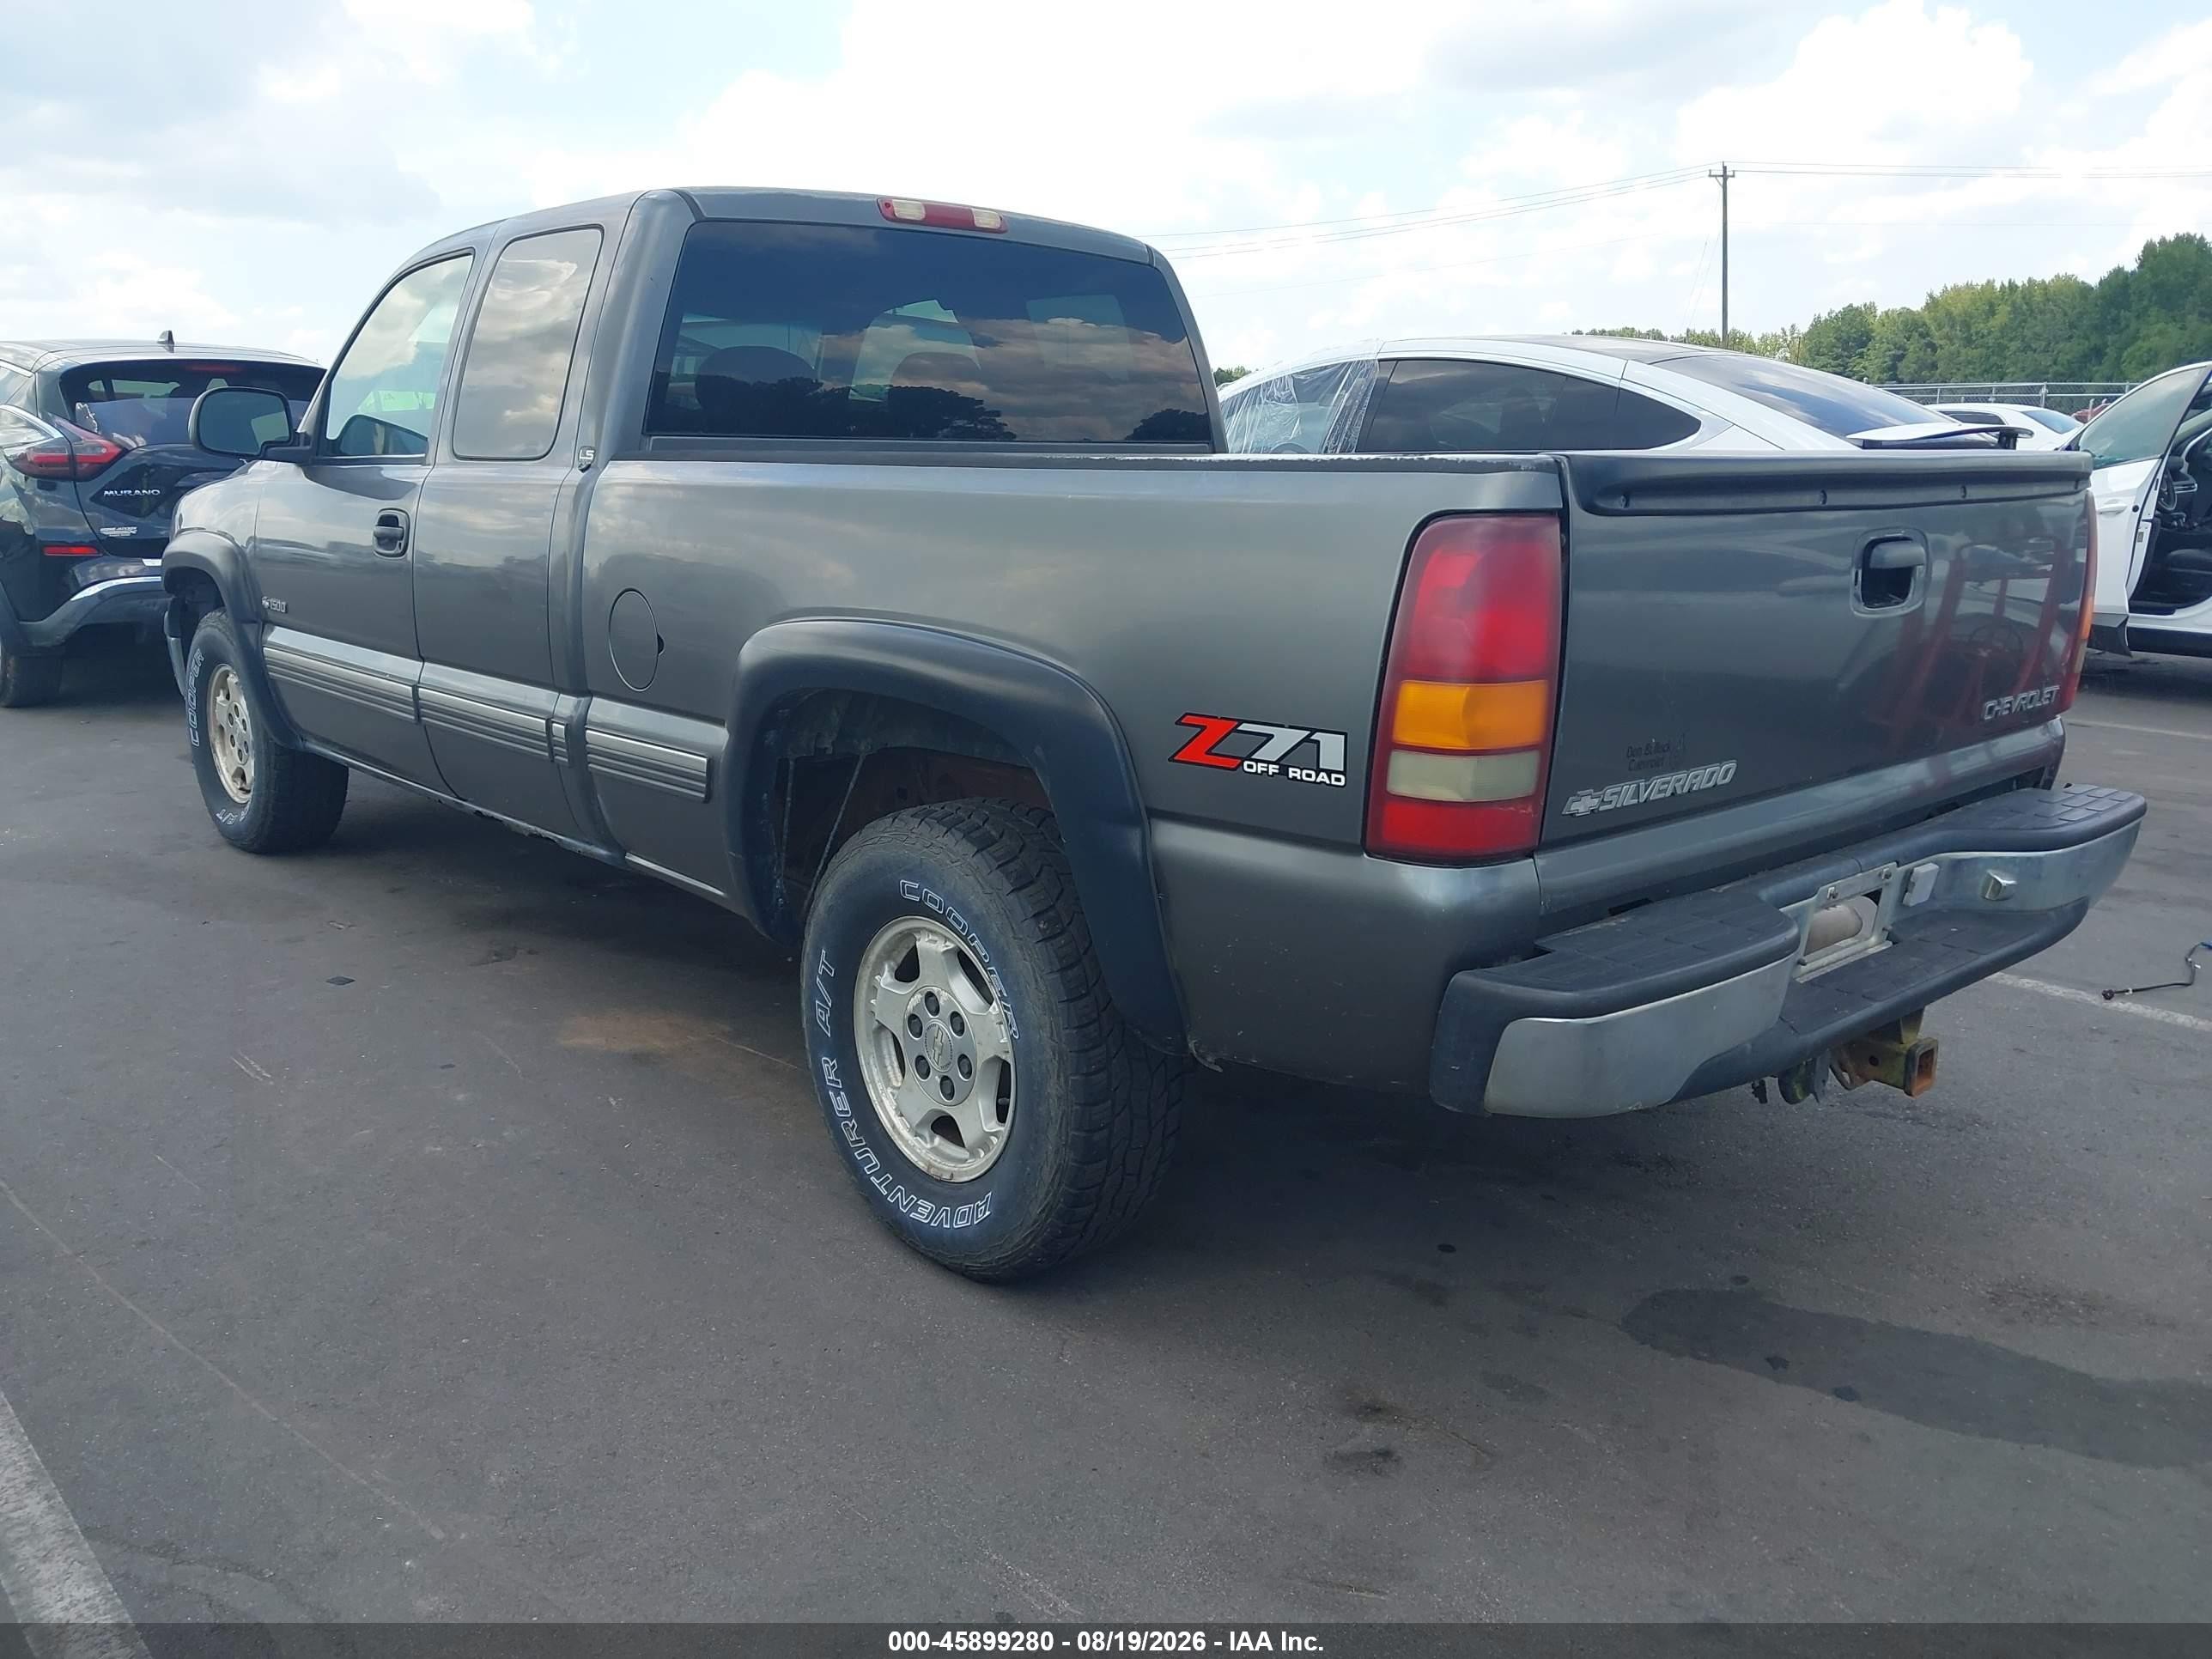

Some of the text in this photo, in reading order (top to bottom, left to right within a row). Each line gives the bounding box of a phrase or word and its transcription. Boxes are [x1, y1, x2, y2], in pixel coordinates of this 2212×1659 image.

[579, 449, 594, 460] LS
[187, 648, 204, 747] COOPER
[1984, 685, 2060, 720] CHEVROLET
[1170, 713, 1346, 771] Z71
[1243, 760, 1346, 787] OFF ROAD
[1598, 760, 1738, 811] SILVERADO
[900, 879, 1020, 1040] COOPER
[816, 948, 993, 1229] ADVENTURER A/T
